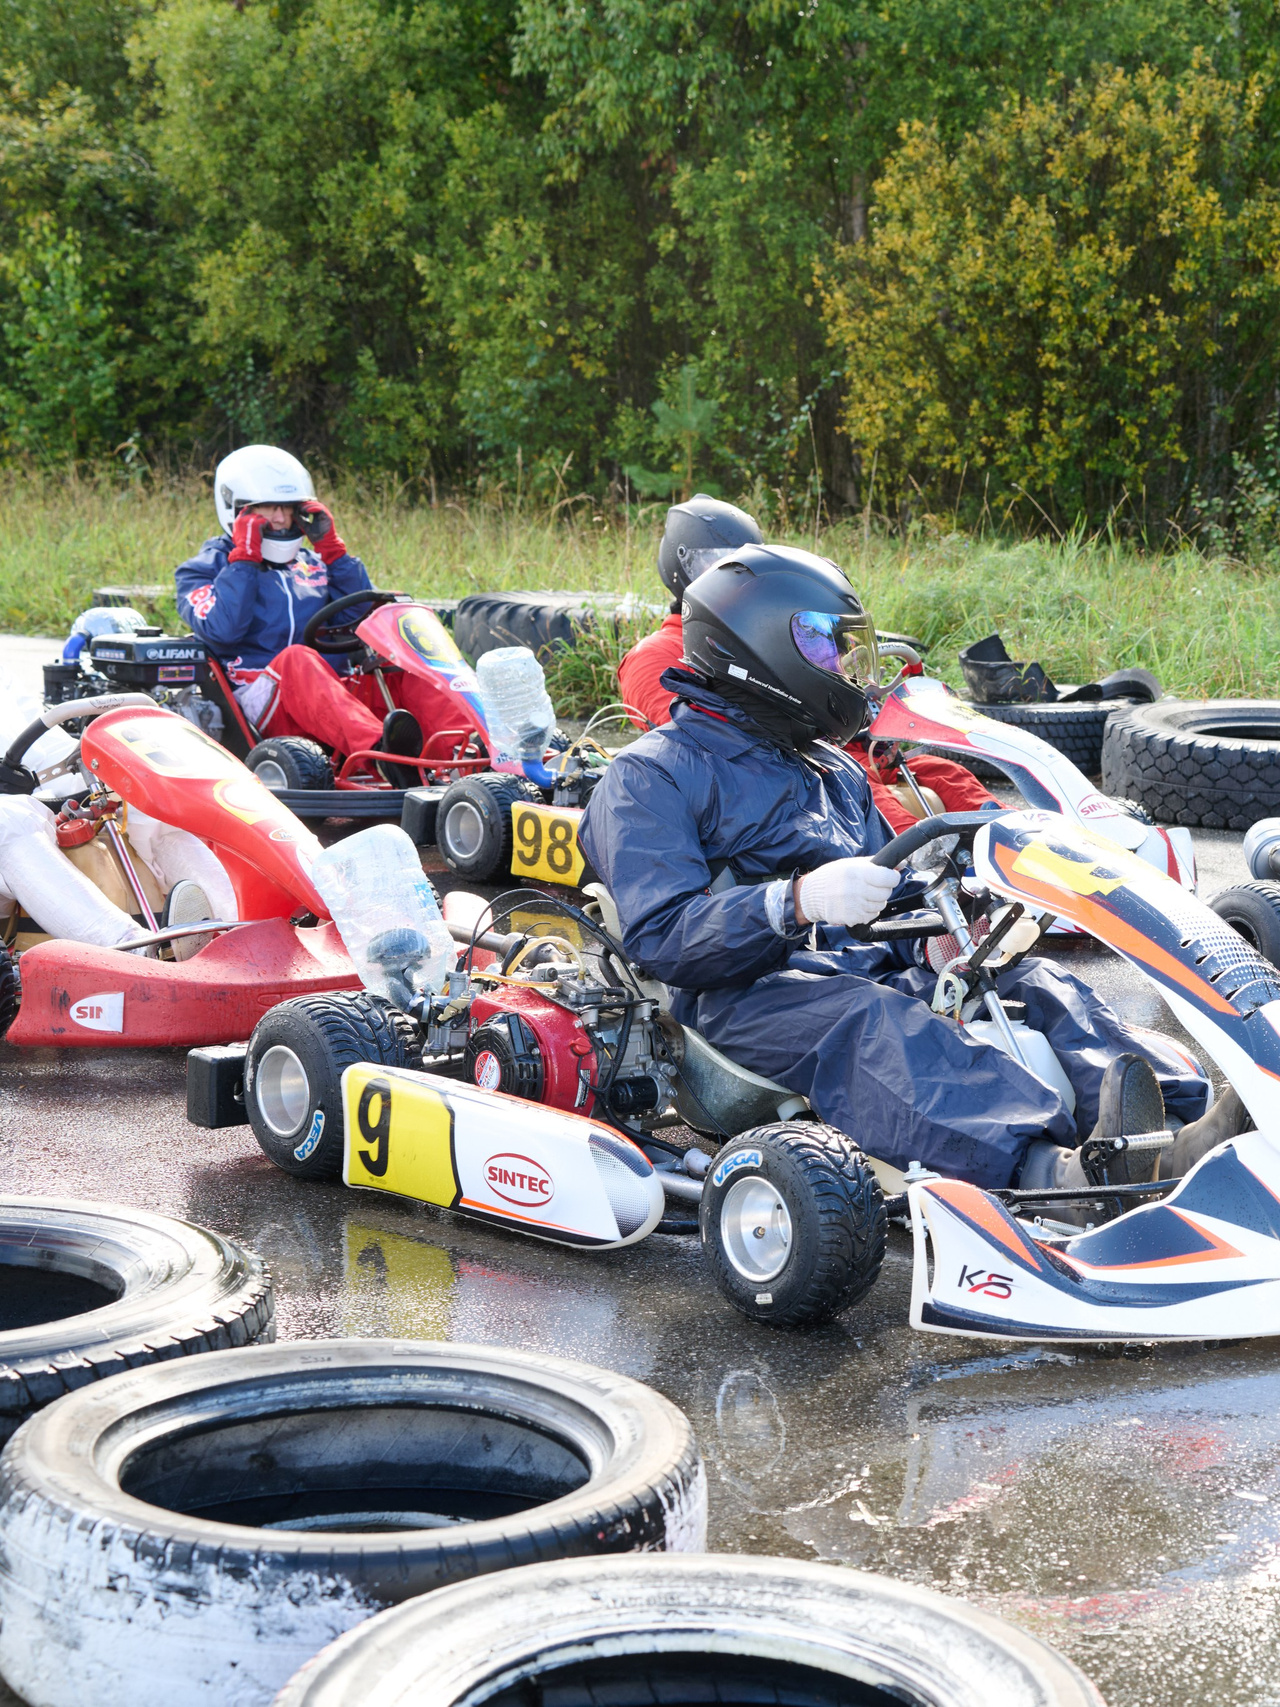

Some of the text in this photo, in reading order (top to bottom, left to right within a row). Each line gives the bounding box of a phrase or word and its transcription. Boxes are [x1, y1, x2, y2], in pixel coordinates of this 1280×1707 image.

[159, 649, 196, 659] LIFAN
[517, 810, 573, 875] 98
[294, 1113, 323, 1159] VEGA
[357, 1077, 392, 1177] 9
[487, 1165, 550, 1196] SINTEC
[714, 1152, 760, 1184] VEGA
